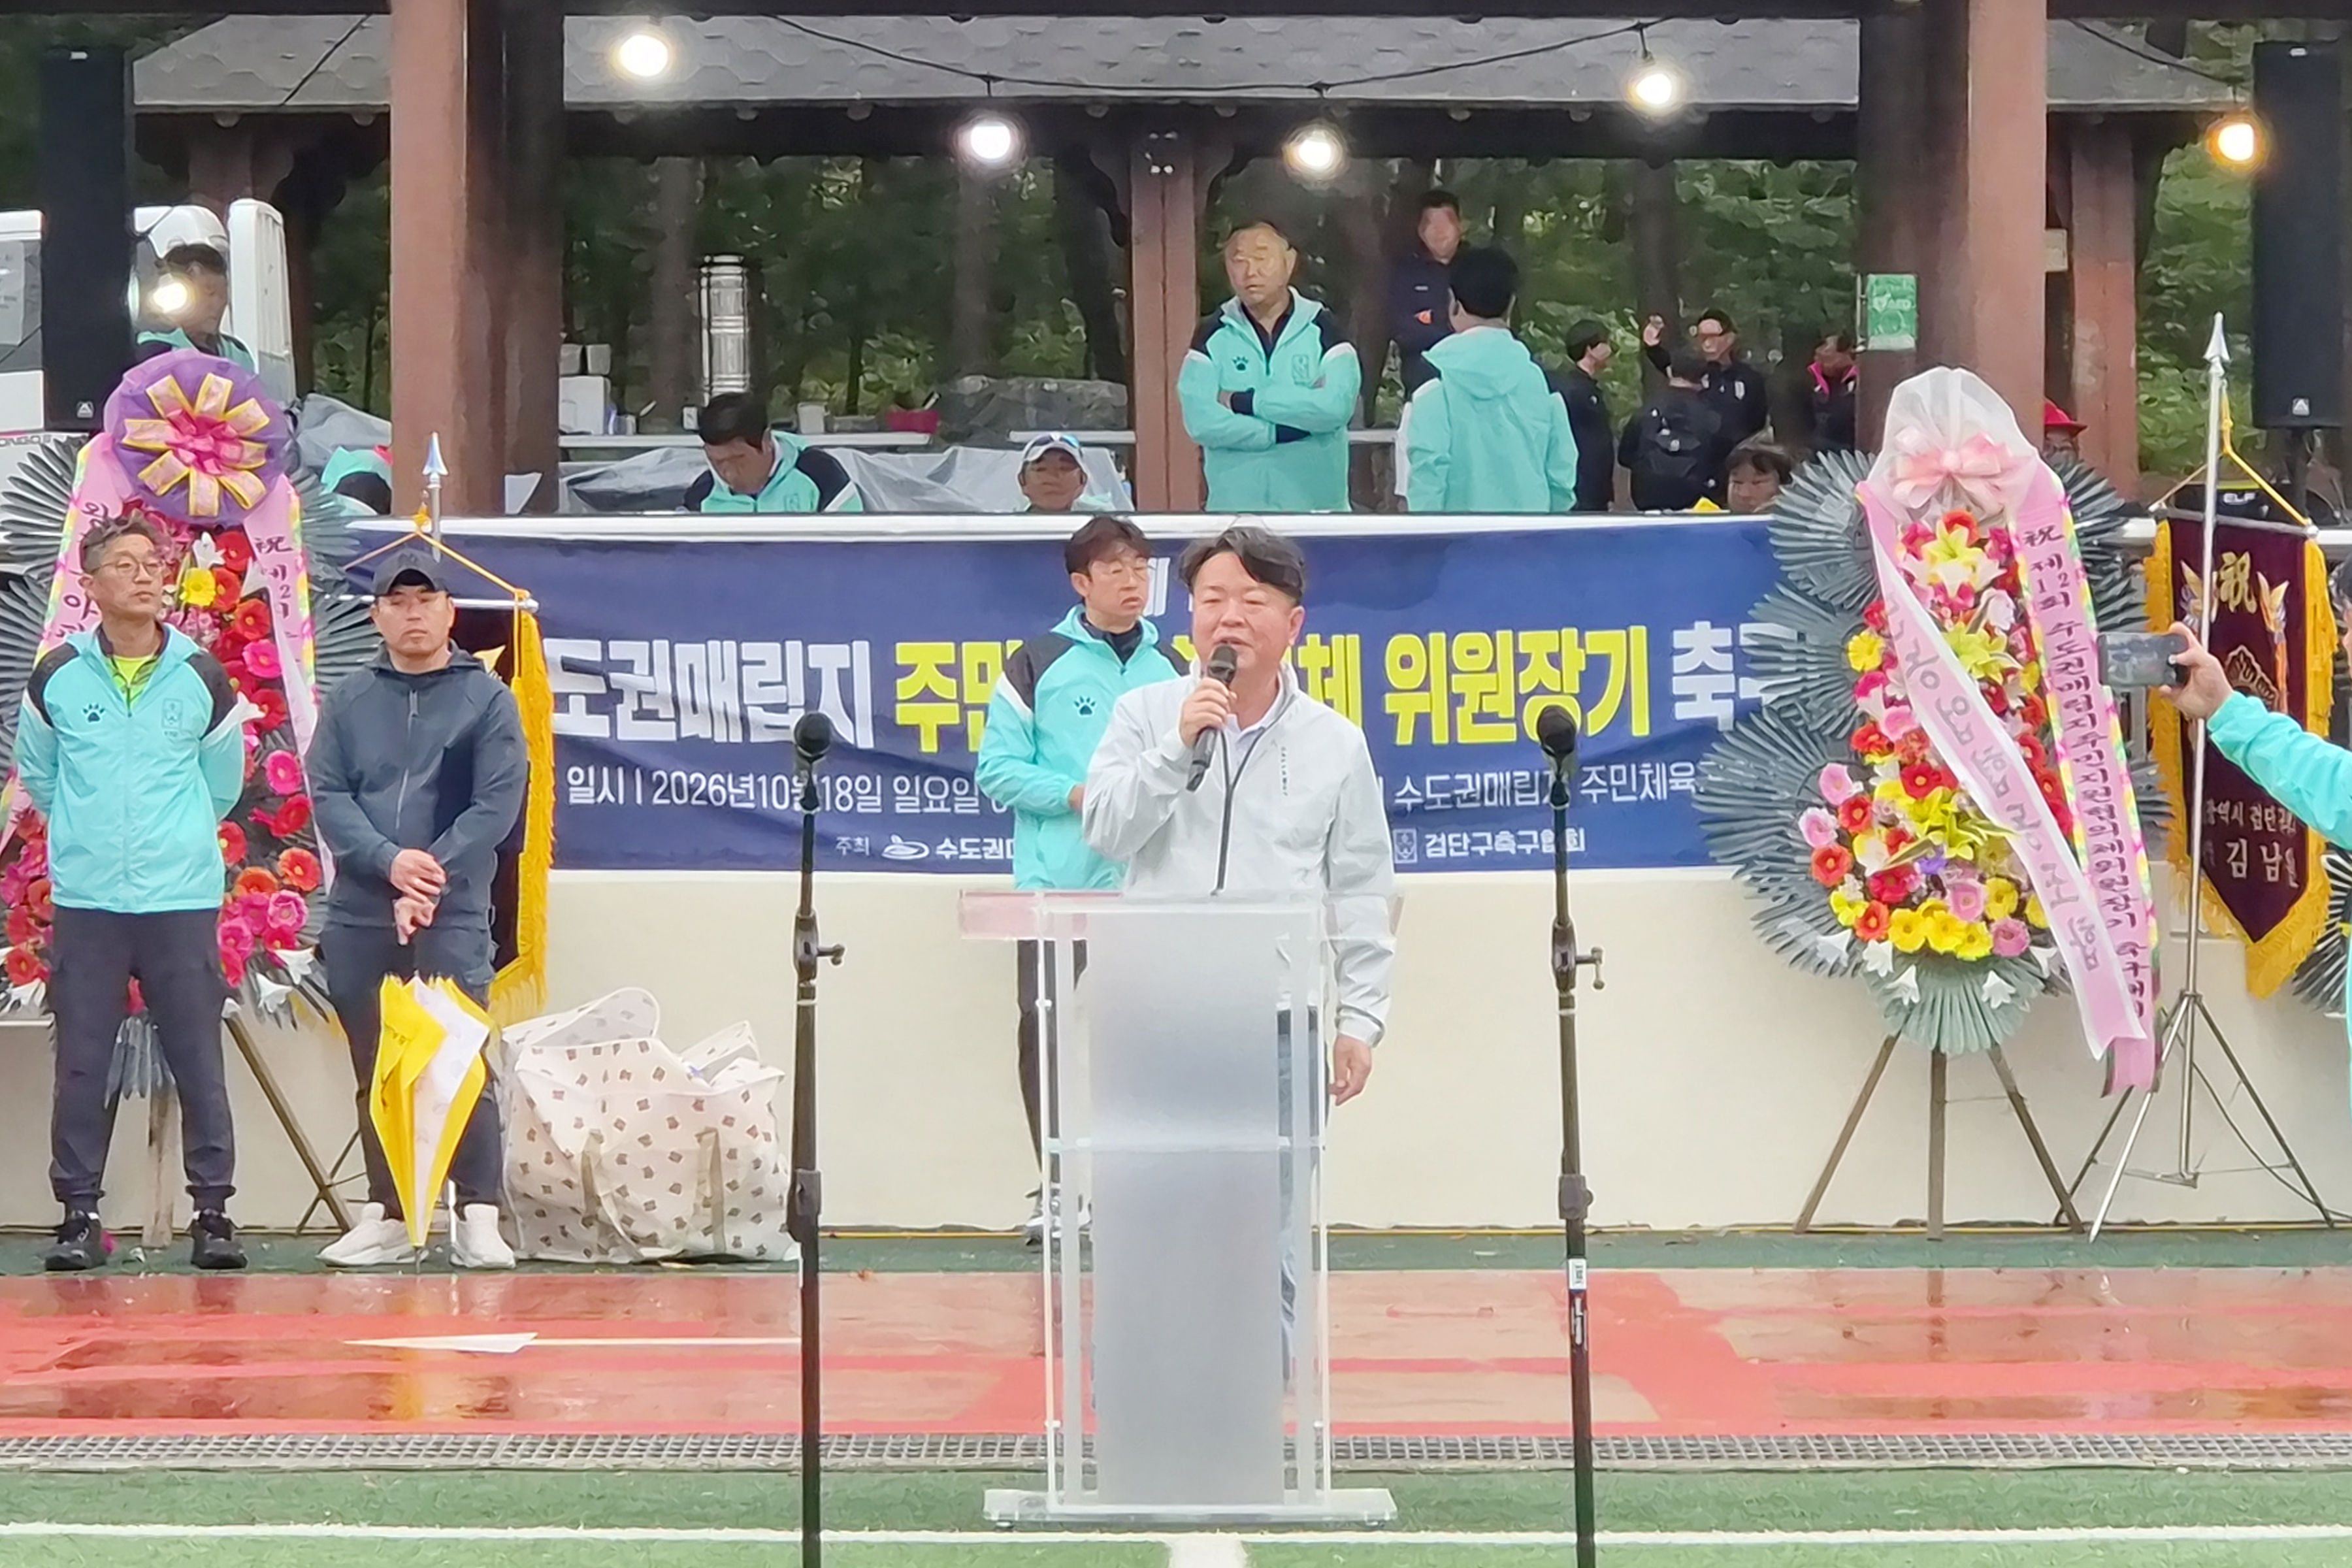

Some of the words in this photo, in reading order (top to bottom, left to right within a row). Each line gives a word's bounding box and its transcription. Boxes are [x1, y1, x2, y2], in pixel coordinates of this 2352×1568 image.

[2023, 525, 2065, 547] 祝
[544, 638, 874, 749] 도권매립지
[1384, 625, 1650, 745] 위원장기
[566, 765, 625, 806] 일시
[892, 775, 979, 814] 일요일
[1580, 760, 1696, 804] 주민체육
[835, 836, 870, 857] 주최
[936, 837, 1017, 859] 수도권
